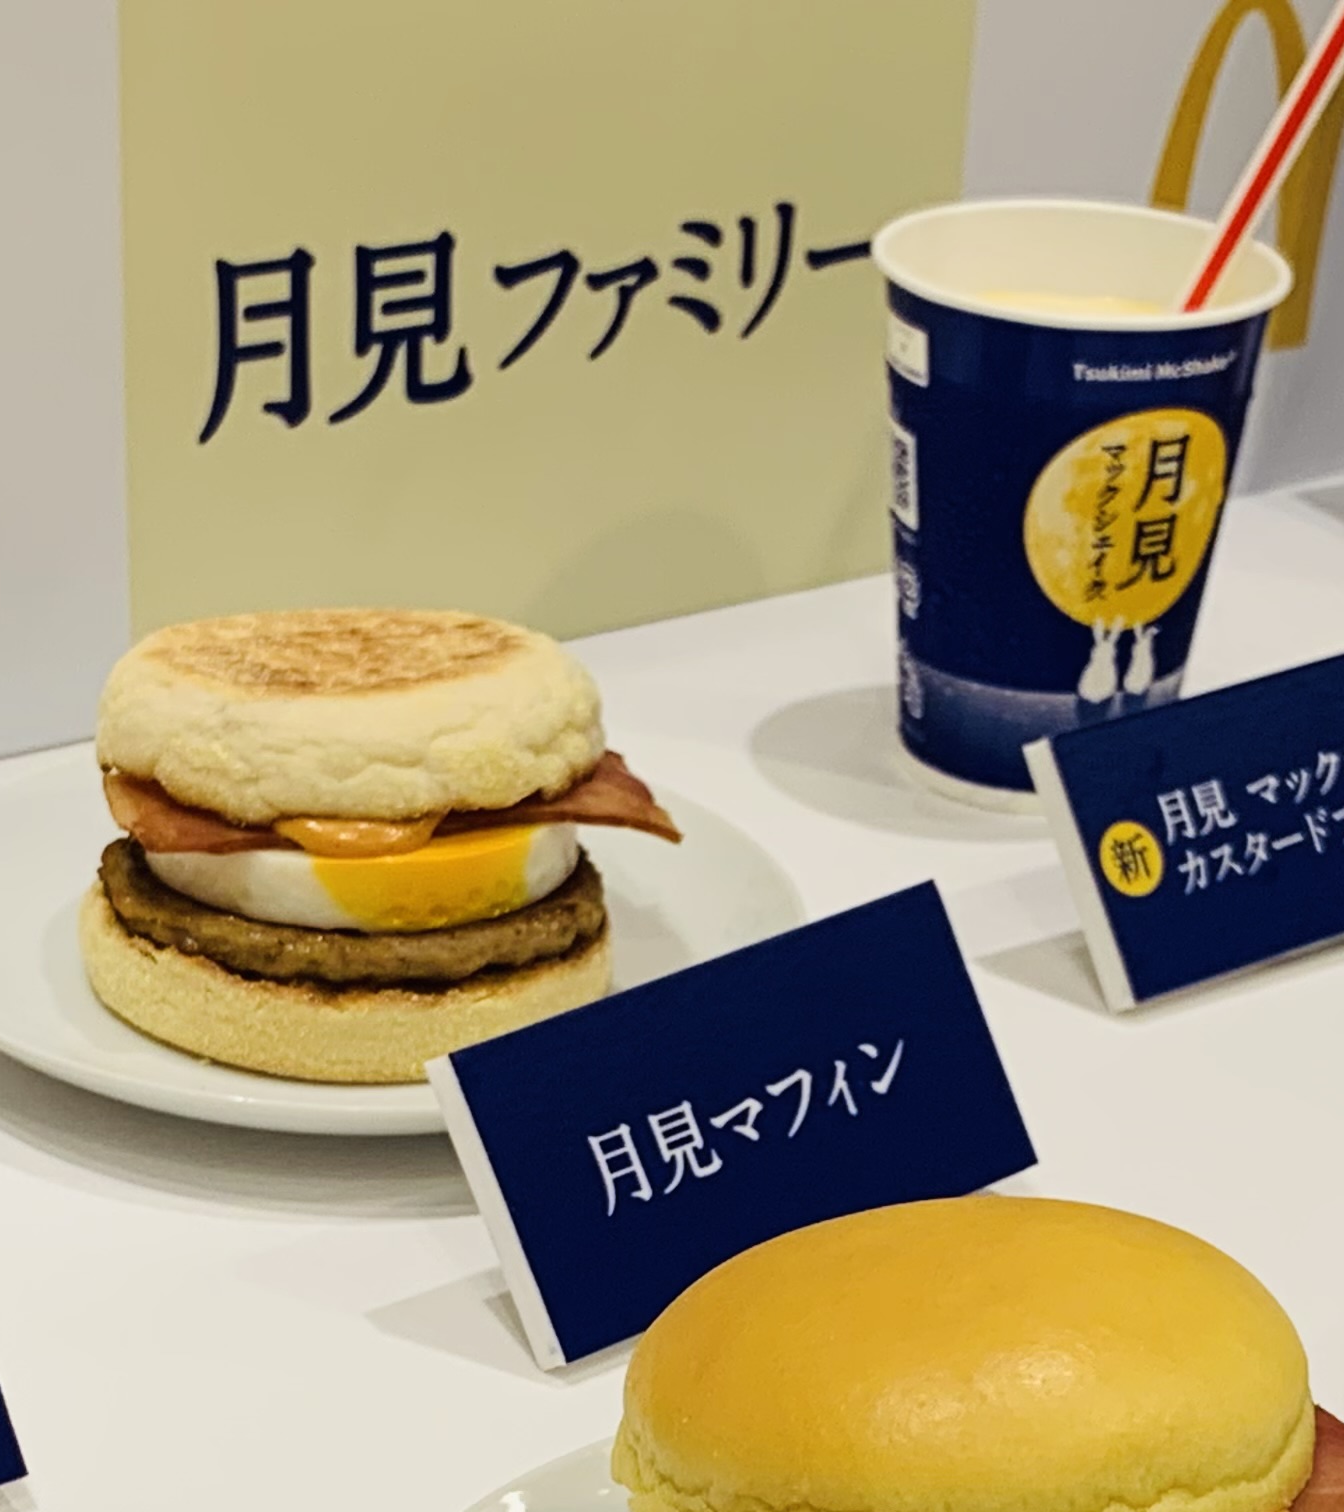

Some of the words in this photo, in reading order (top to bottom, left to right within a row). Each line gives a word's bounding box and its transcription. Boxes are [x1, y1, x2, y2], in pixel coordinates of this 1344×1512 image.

[199, 202, 873, 444] 月見ファミリー
[1115, 434, 1190, 591] 月見
[1110, 835, 1153, 885] 新
[1156, 780, 1238, 846] 月見
[587, 1040, 904, 1217] 月見マフィン
